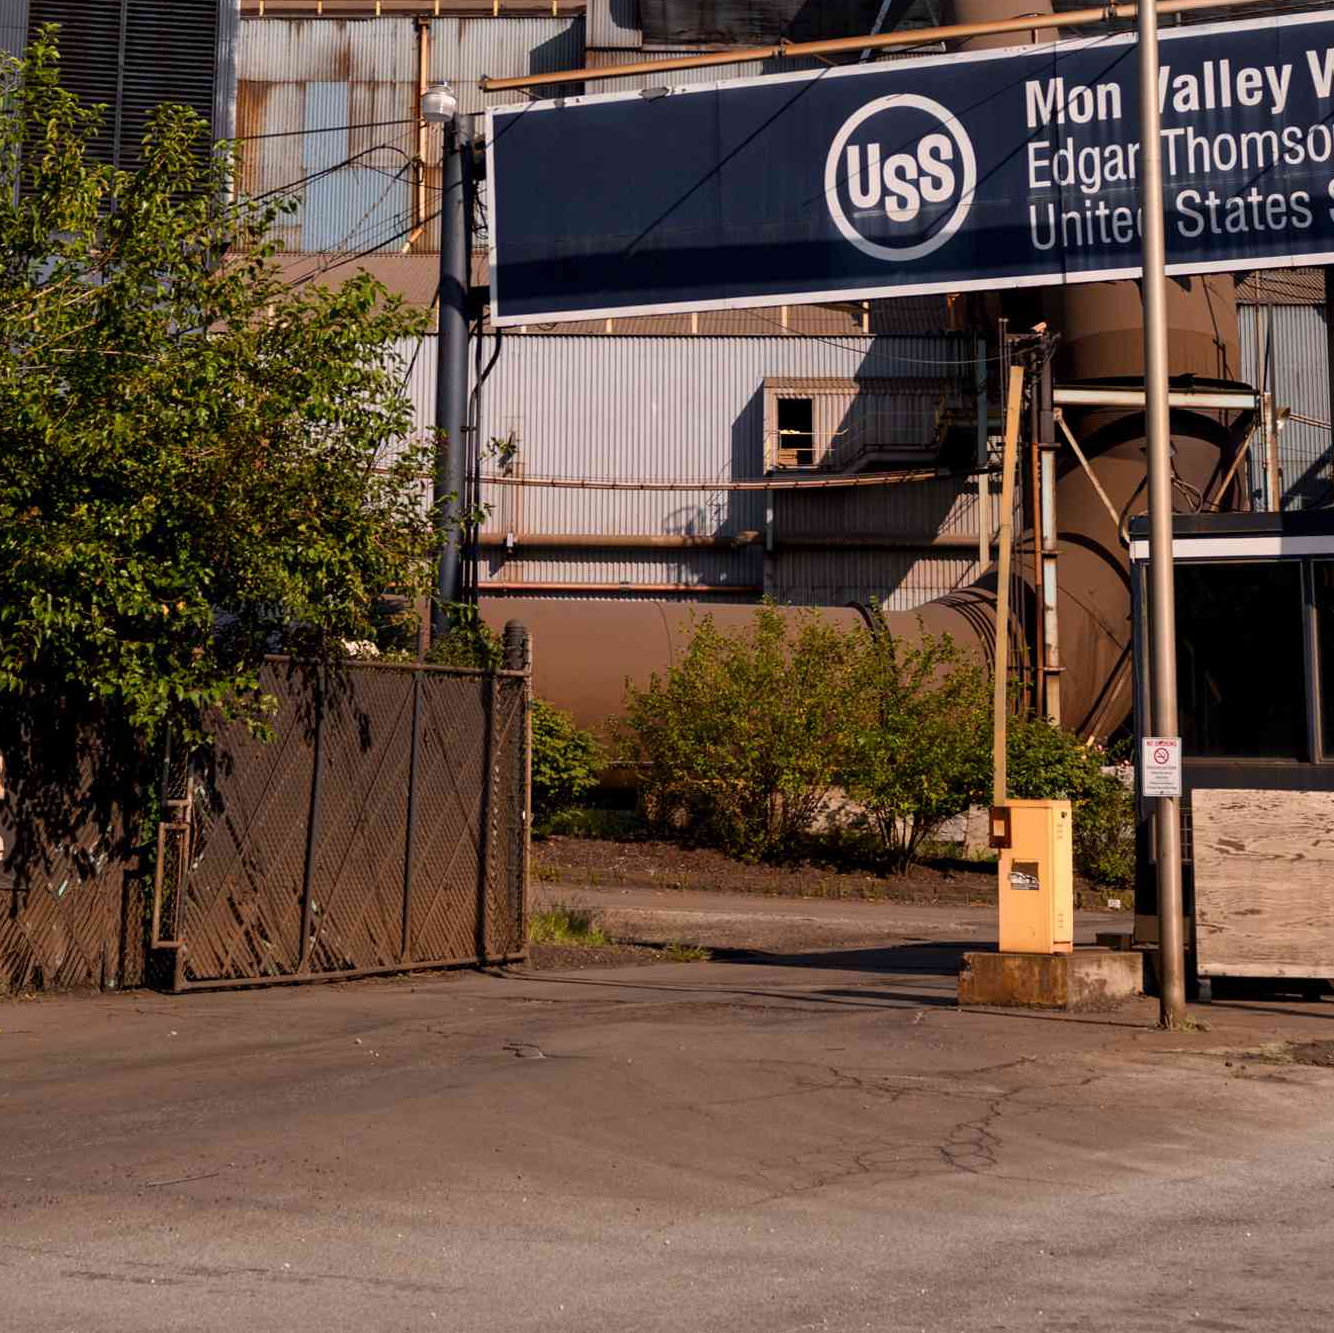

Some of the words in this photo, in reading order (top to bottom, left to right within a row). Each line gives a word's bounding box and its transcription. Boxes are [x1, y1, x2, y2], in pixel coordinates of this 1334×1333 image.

[1025, 77, 1122, 128] Mon
[847, 133, 955, 222] USS
[1027, 137, 1140, 194] Edgar
[1029, 199, 1144, 250] Unite
[1175, 186, 1313, 238] States
